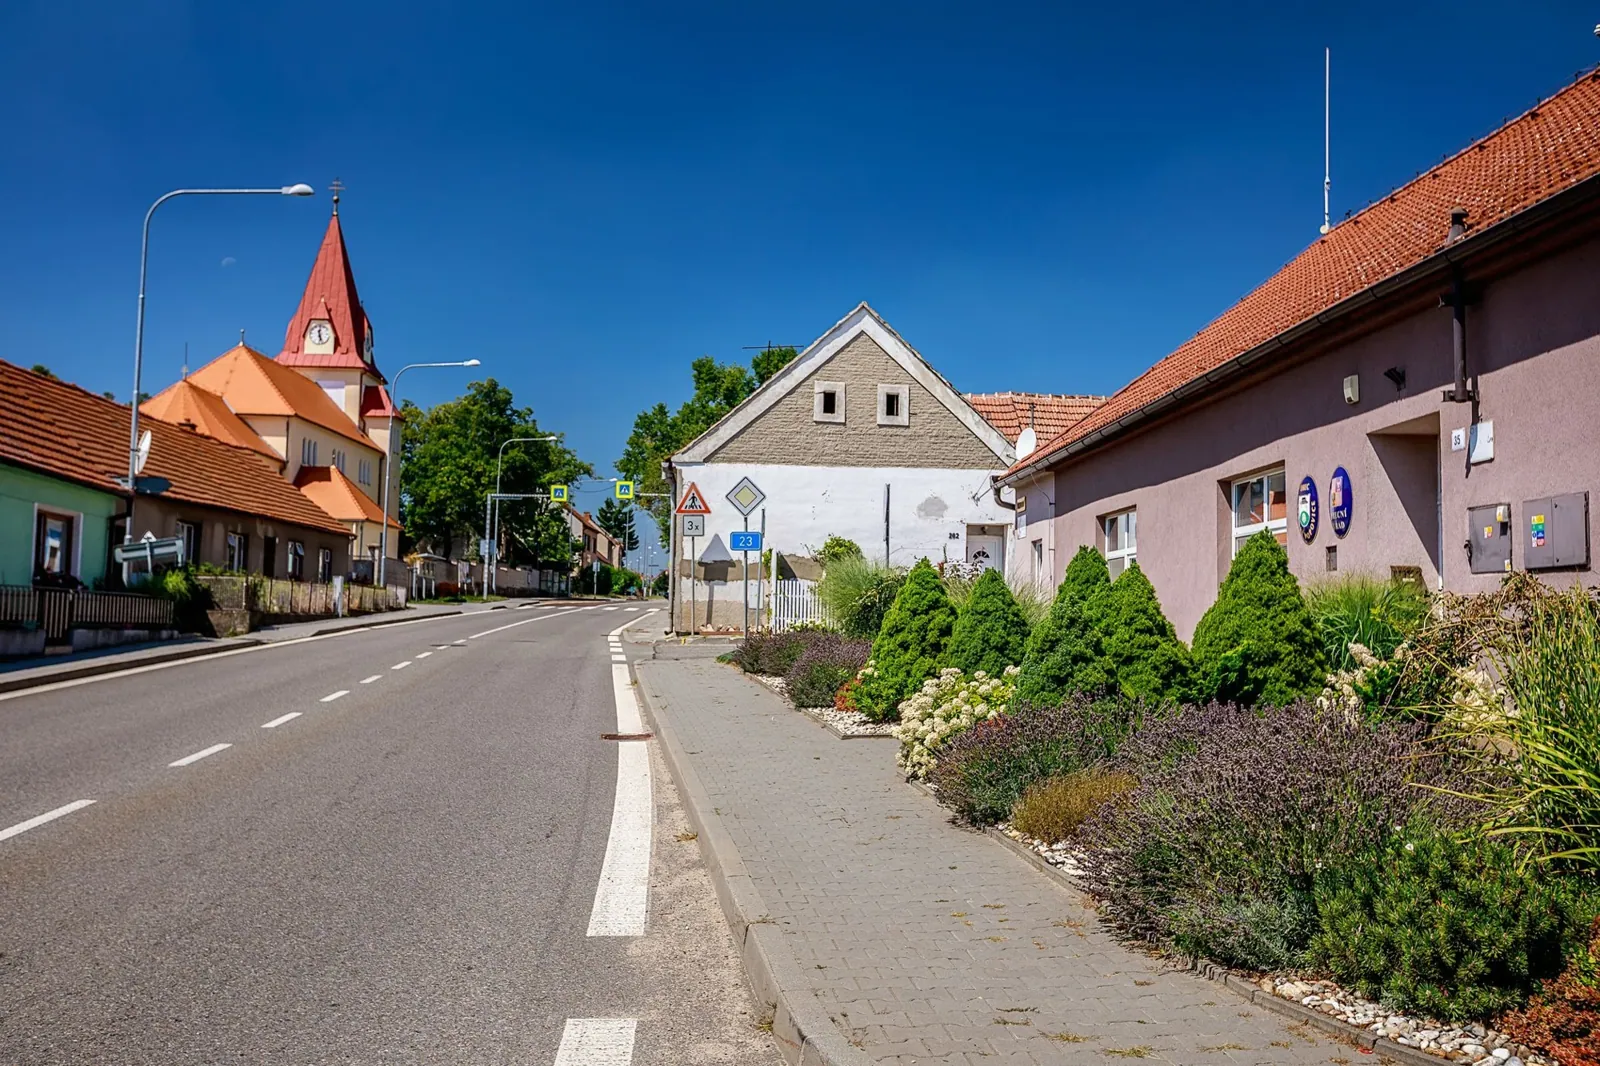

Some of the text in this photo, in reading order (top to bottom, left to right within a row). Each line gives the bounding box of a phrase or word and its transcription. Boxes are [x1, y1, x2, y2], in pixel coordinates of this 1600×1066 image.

[1454, 434, 1461, 446] 35
[687, 520, 700, 531] 3x
[739, 536, 753, 547] 23
